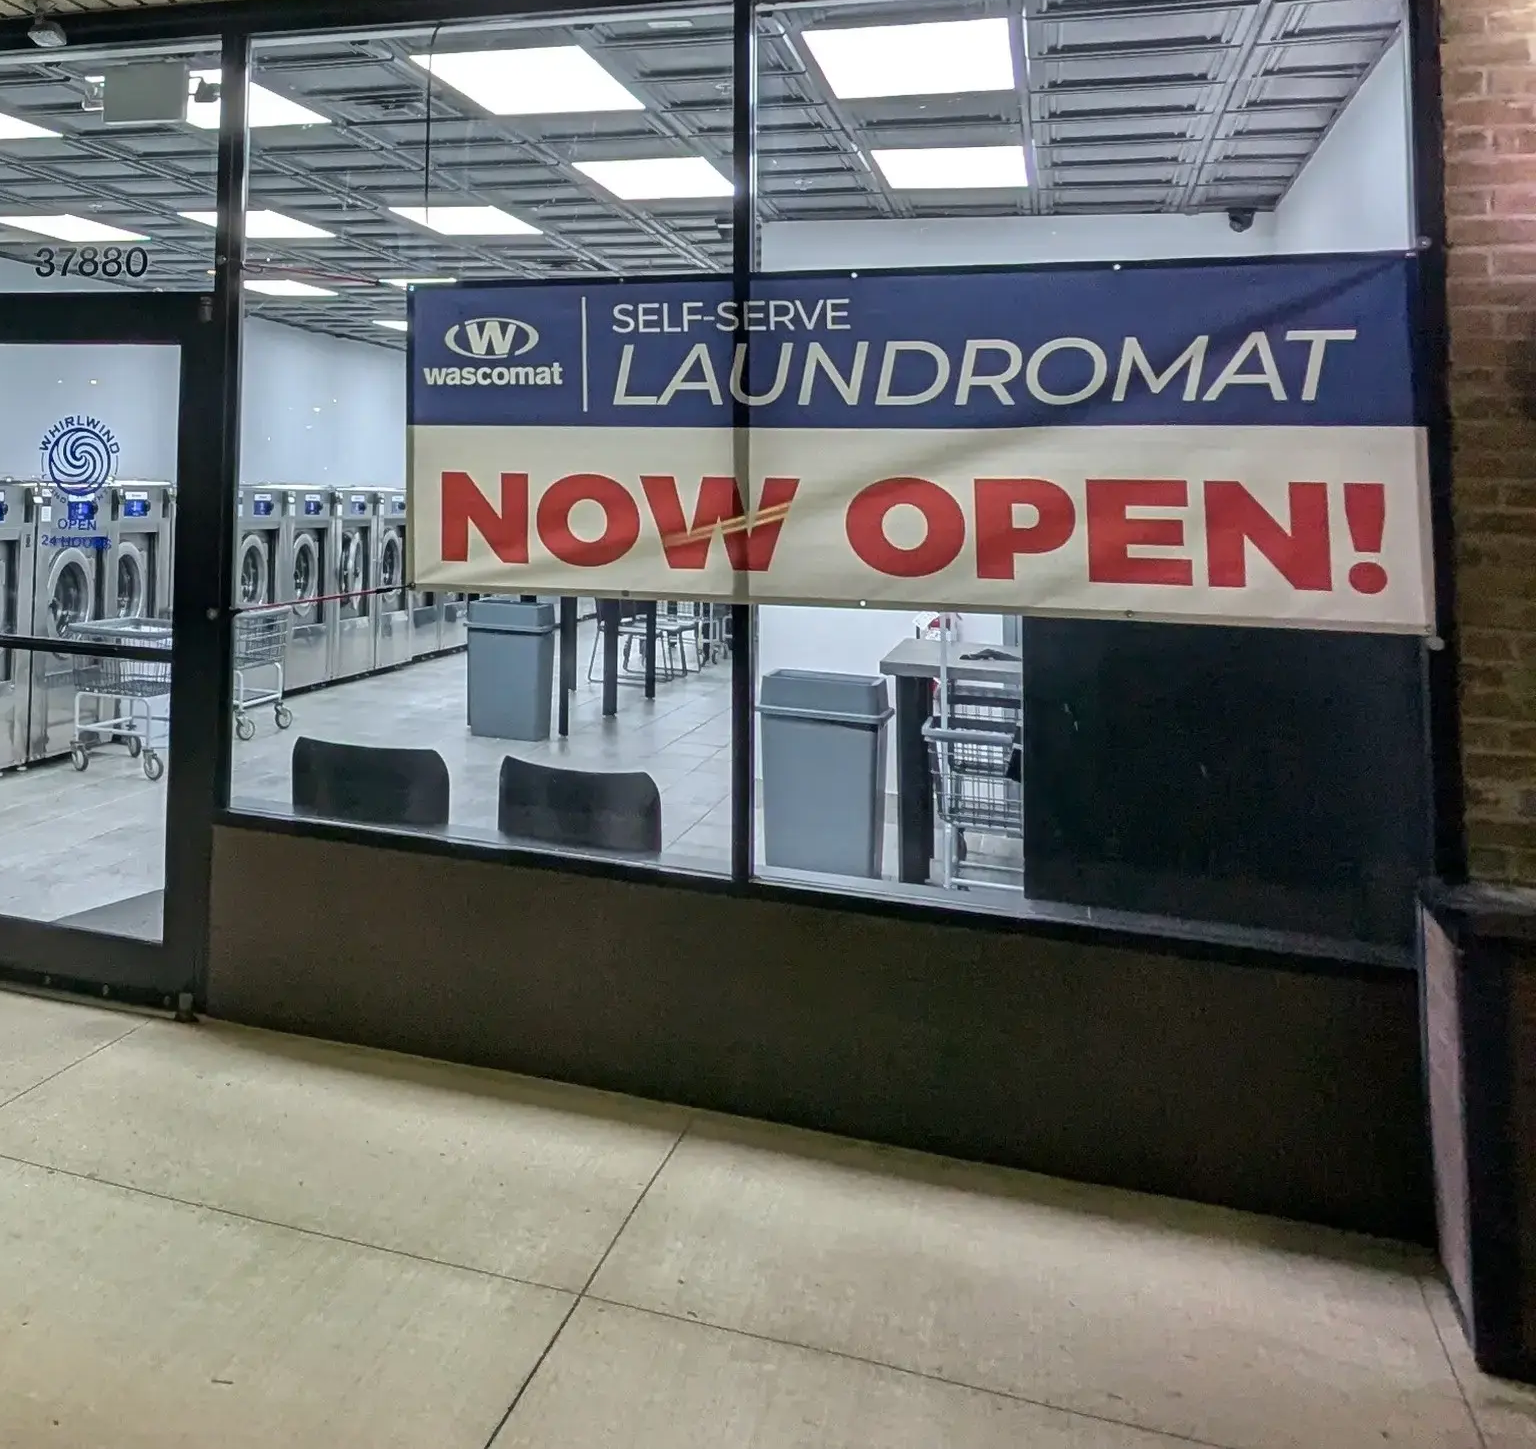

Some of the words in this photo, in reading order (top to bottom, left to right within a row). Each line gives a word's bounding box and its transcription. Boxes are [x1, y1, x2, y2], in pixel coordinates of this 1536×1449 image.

[34, 247, 149, 278] 37880
[612, 298, 851, 333] SELF-SERVE
[423, 362, 563, 386] wascomat
[612, 329, 1357, 406] LAUNDROMAT
[39, 415, 120, 454] WHIRLWIND
[57, 518, 97, 531] OPEN
[441, 471, 799, 572] NOW
[846, 478, 1388, 594] OPEN!
[41, 534, 58, 548] 24
[61, 535, 112, 550] HOUS
